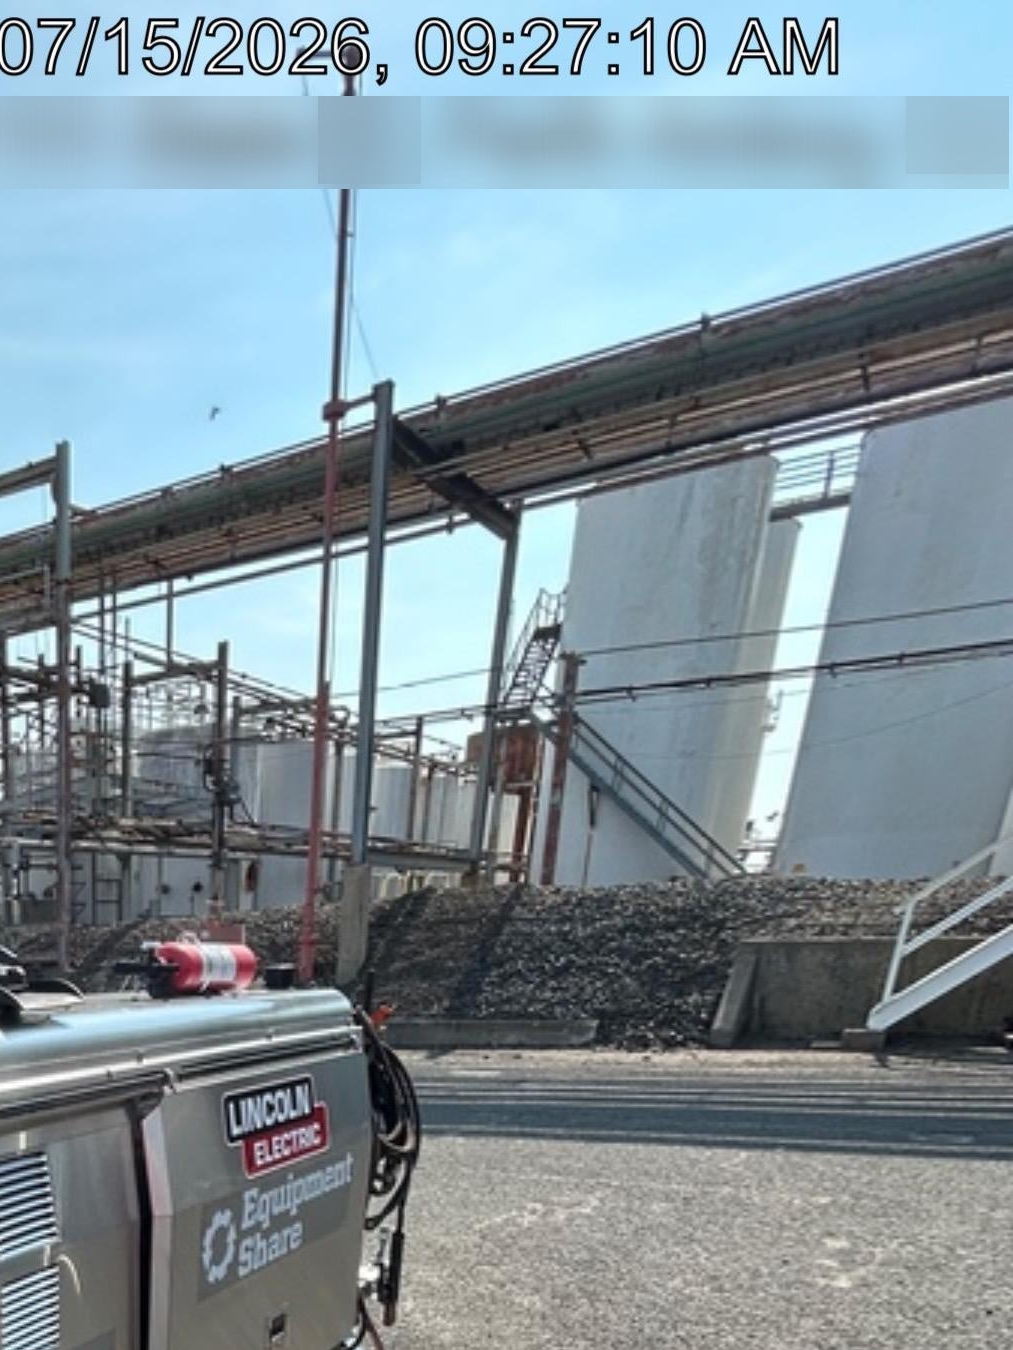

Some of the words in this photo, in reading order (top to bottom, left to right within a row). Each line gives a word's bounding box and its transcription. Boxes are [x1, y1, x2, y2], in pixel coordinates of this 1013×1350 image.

[228, 1083, 311, 1137] LINCOLN
[253, 1123, 321, 1167] ELECTRIC
[241, 1151, 354, 1230] Equipment
[238, 1221, 303, 1277] Share
